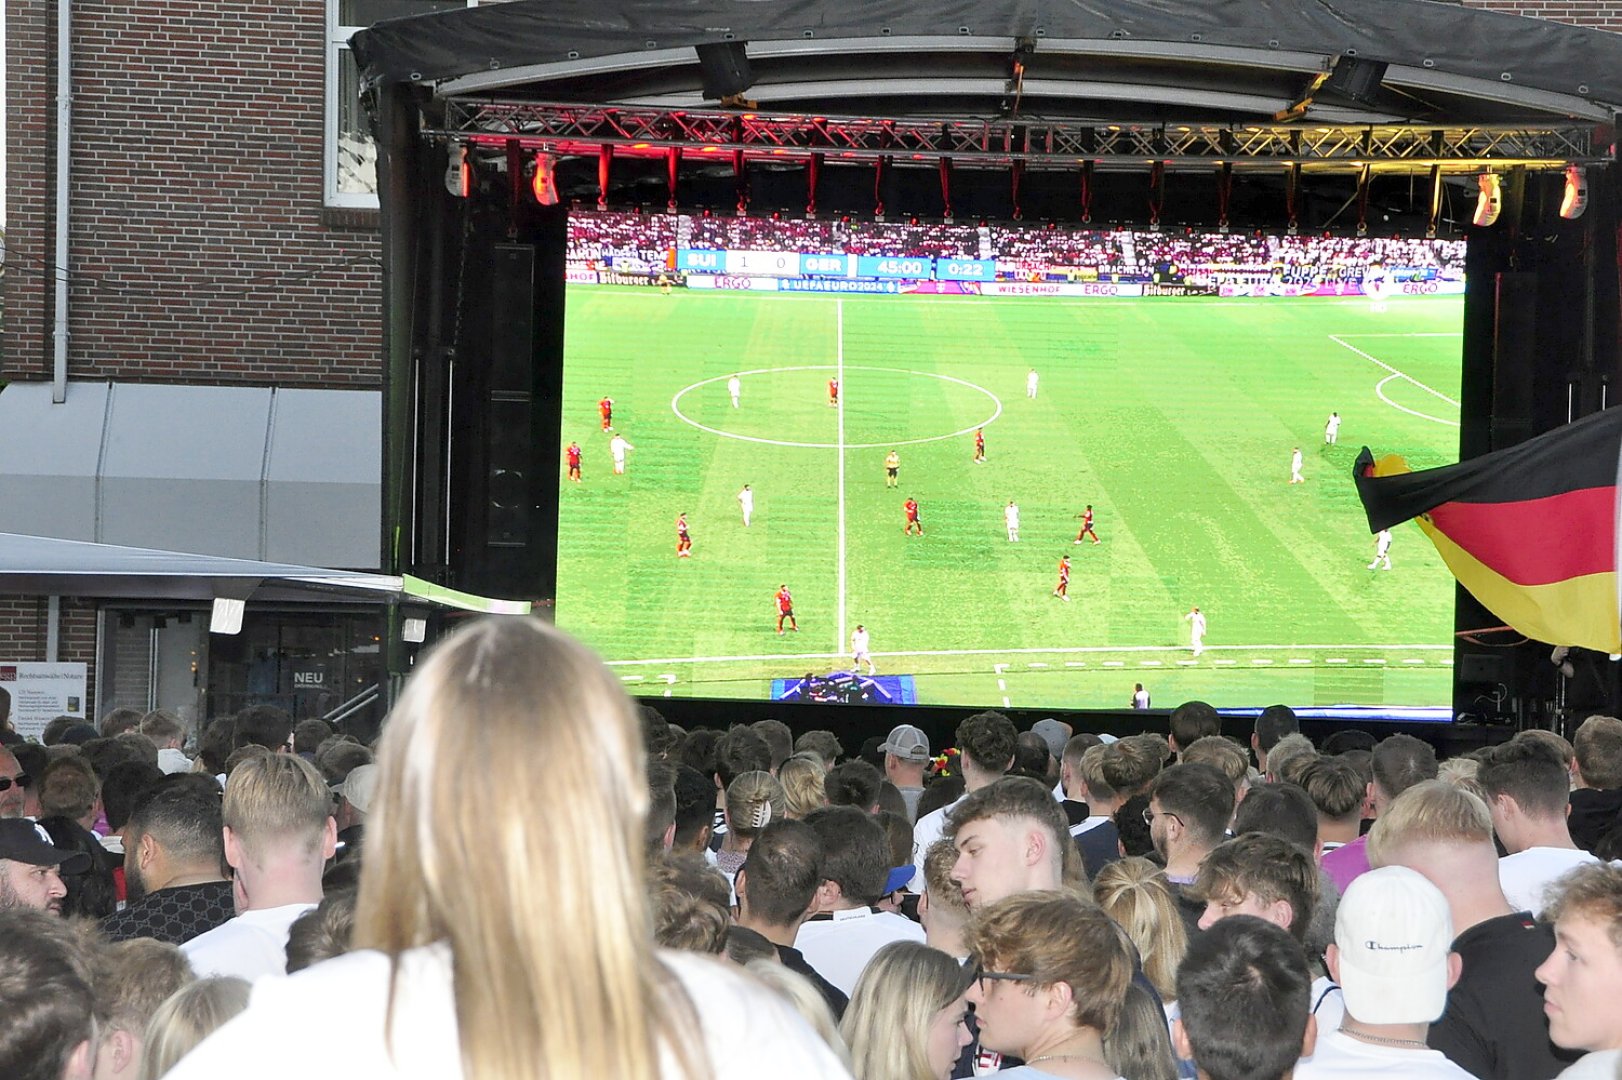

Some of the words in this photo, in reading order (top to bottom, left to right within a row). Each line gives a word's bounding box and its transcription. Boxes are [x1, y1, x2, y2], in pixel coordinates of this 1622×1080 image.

[687, 253, 717, 267] SUI
[741, 256, 748, 268] 1
[776, 257, 786, 269] 0
[805, 258, 842, 272] GER
[877, 260, 923, 275] 45:00
[947, 263, 984, 276] 0:22
[599, 271, 649, 285] Bitburger
[714, 277, 751, 289] ERGO
[998, 285, 1061, 294] WIESENHOF
[1084, 285, 1118, 295] ERGO
[1403, 283, 1438, 294] ERGO
[294, 672, 323, 684] NEU
